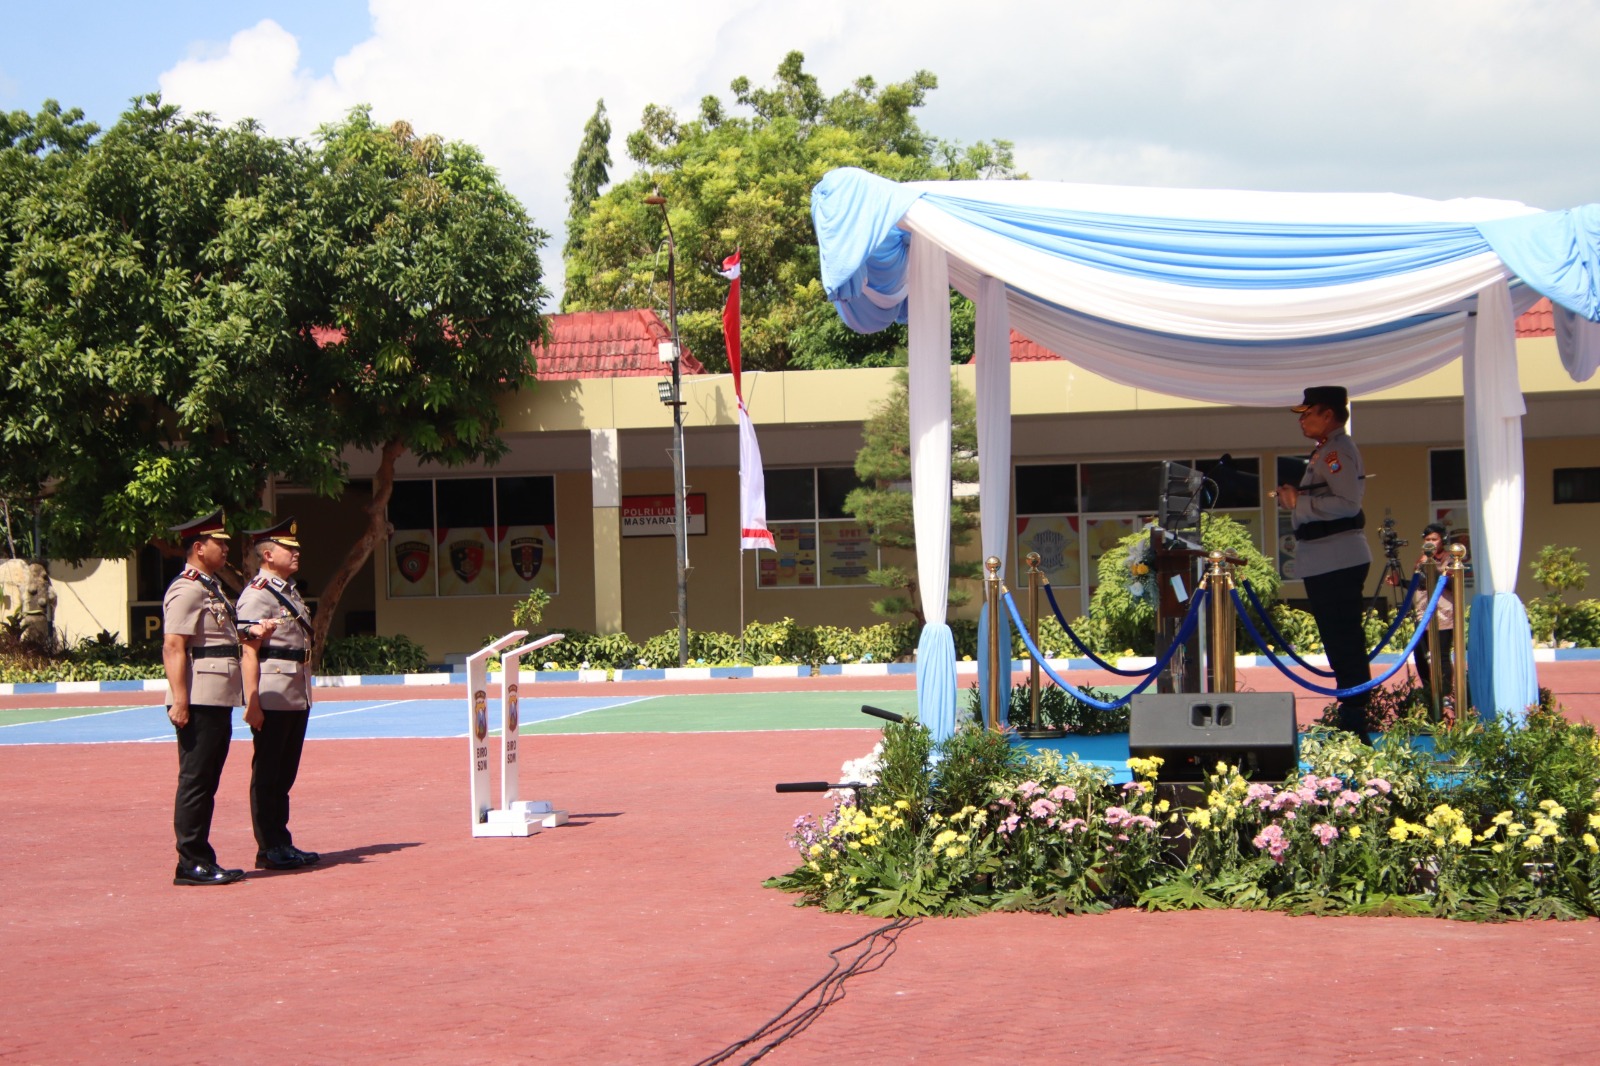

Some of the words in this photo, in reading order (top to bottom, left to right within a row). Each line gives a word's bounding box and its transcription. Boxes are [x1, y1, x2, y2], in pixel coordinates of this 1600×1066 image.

[623, 508, 654, 516] POLRI
[657, 507, 692, 515] UNK
[624, 516, 692, 526] MASYARAT
[506, 740, 517, 751] BIRO
[476, 746, 488, 758] BIRO
[477, 760, 488, 771] SDM
